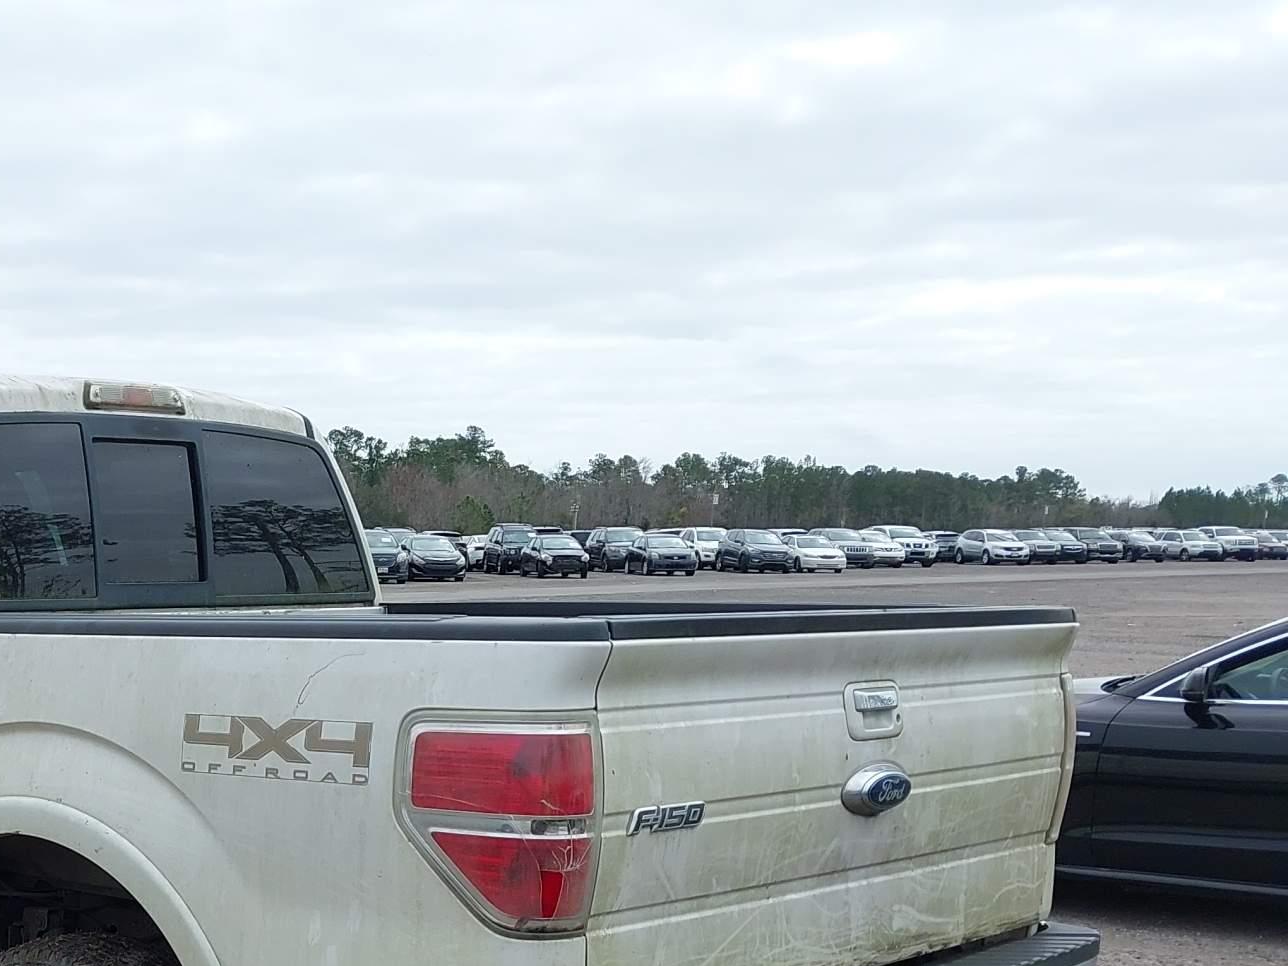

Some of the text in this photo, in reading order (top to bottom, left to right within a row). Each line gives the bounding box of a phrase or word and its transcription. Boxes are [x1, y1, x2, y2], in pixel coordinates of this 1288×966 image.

[183, 713, 373, 768] 4X4
[878, 778, 906, 803] Ford
[627, 801, 705, 837] F-150
